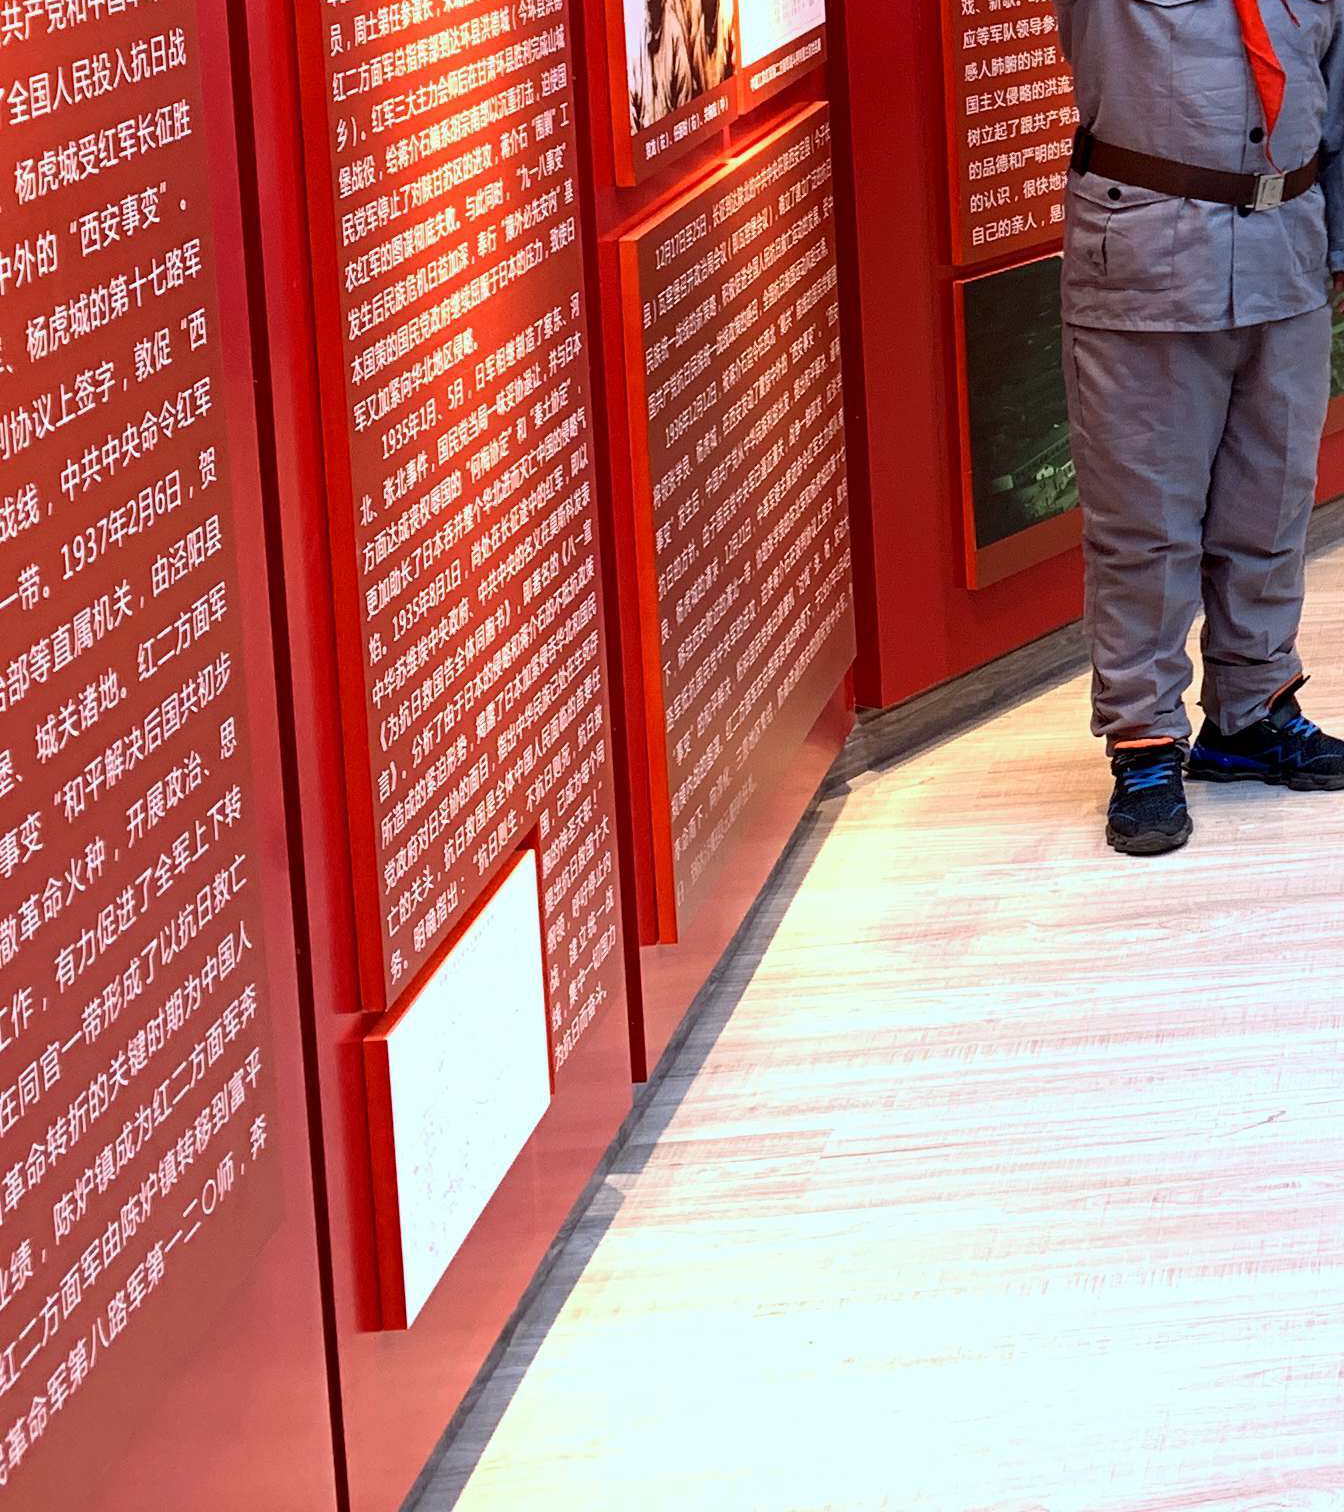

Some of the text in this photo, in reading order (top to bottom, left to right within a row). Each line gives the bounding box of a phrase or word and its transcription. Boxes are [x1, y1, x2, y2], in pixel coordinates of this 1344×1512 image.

[966, 75, 1073, 116] 国主义侵略的洪流
[972, 203, 1065, 246] 自己的亲人，是
[0, 238, 202, 374] 、杨虎城的第十七路军
